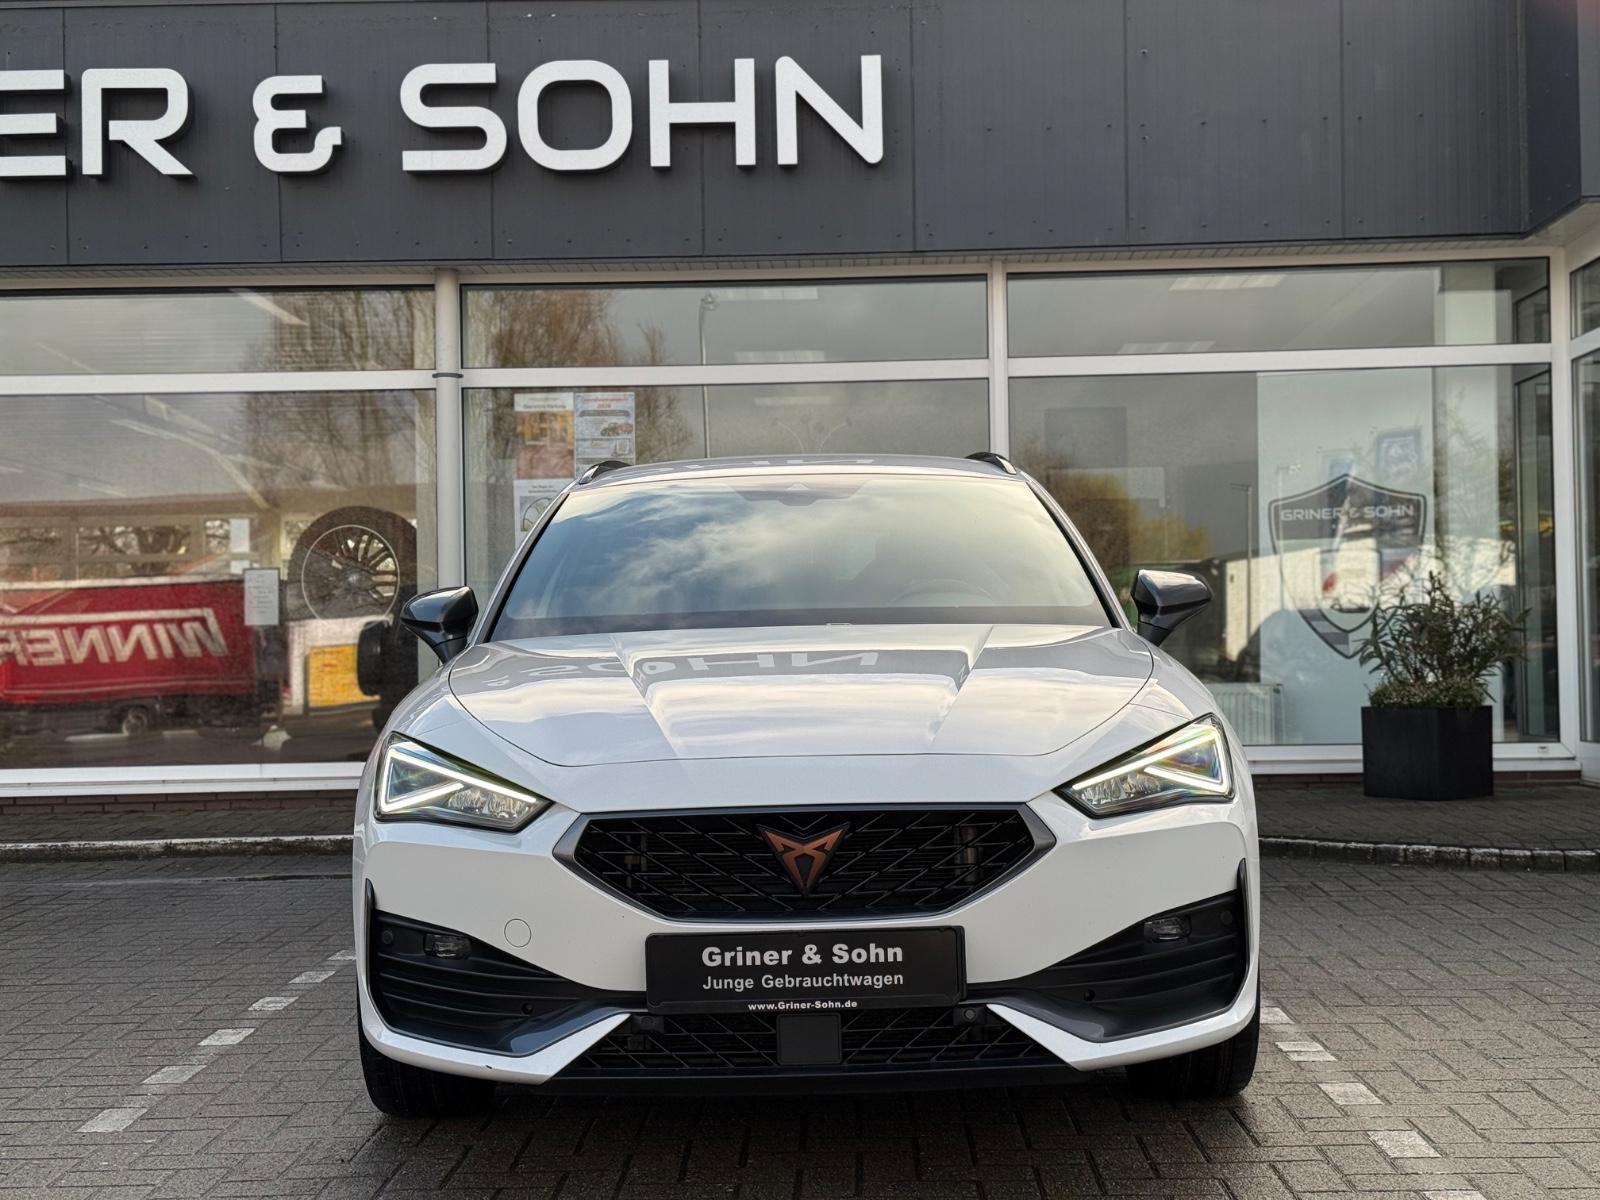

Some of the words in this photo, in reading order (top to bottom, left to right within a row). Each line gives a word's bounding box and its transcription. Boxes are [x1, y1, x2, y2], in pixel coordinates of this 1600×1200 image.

[0, 67, 193, 176] ER
[252, 74, 342, 172] &
[400, 54, 884, 172] SOHN
[1280, 508, 1344, 521] GRINER
[1363, 504, 1413, 518] SOHN
[702, 946, 793, 966] Griner
[801, 944, 822, 965] &
[832, 943, 903, 963] Sohn
[703, 976, 755, 991] Junge
[761, 973, 904, 989] Gebrauchtwagen
[748, 1000, 858, 1011] www.Griner-Sohn.de
